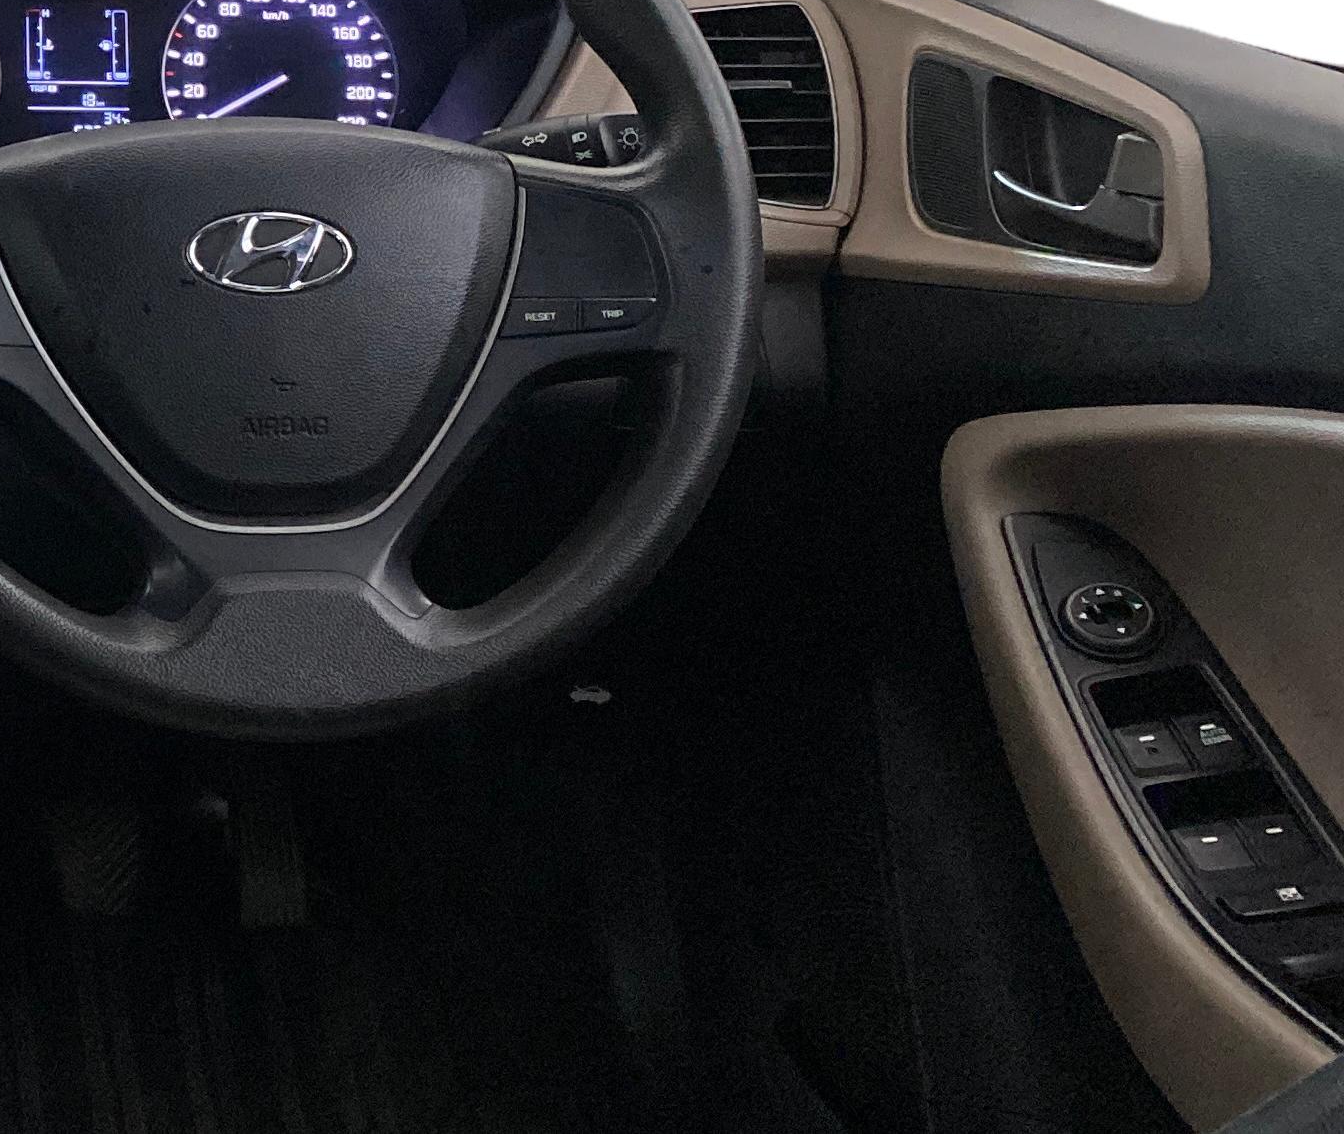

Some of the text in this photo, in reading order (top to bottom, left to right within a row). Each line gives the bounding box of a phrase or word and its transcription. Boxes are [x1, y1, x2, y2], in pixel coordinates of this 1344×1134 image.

[218, 3, 239, 16] 80
[262, 11, 289, 21] km/h
[310, 4, 336, 17] 140
[196, 25, 217, 38] 60
[332, 27, 359, 40] 160
[183, 52, 204, 66] 40
[345, 54, 372, 68] 180
[183, 84, 204, 98] 20
[346, 87, 375, 100] 200
[524, 312, 556, 322] RESET
[602, 310, 624, 318] TRIP
